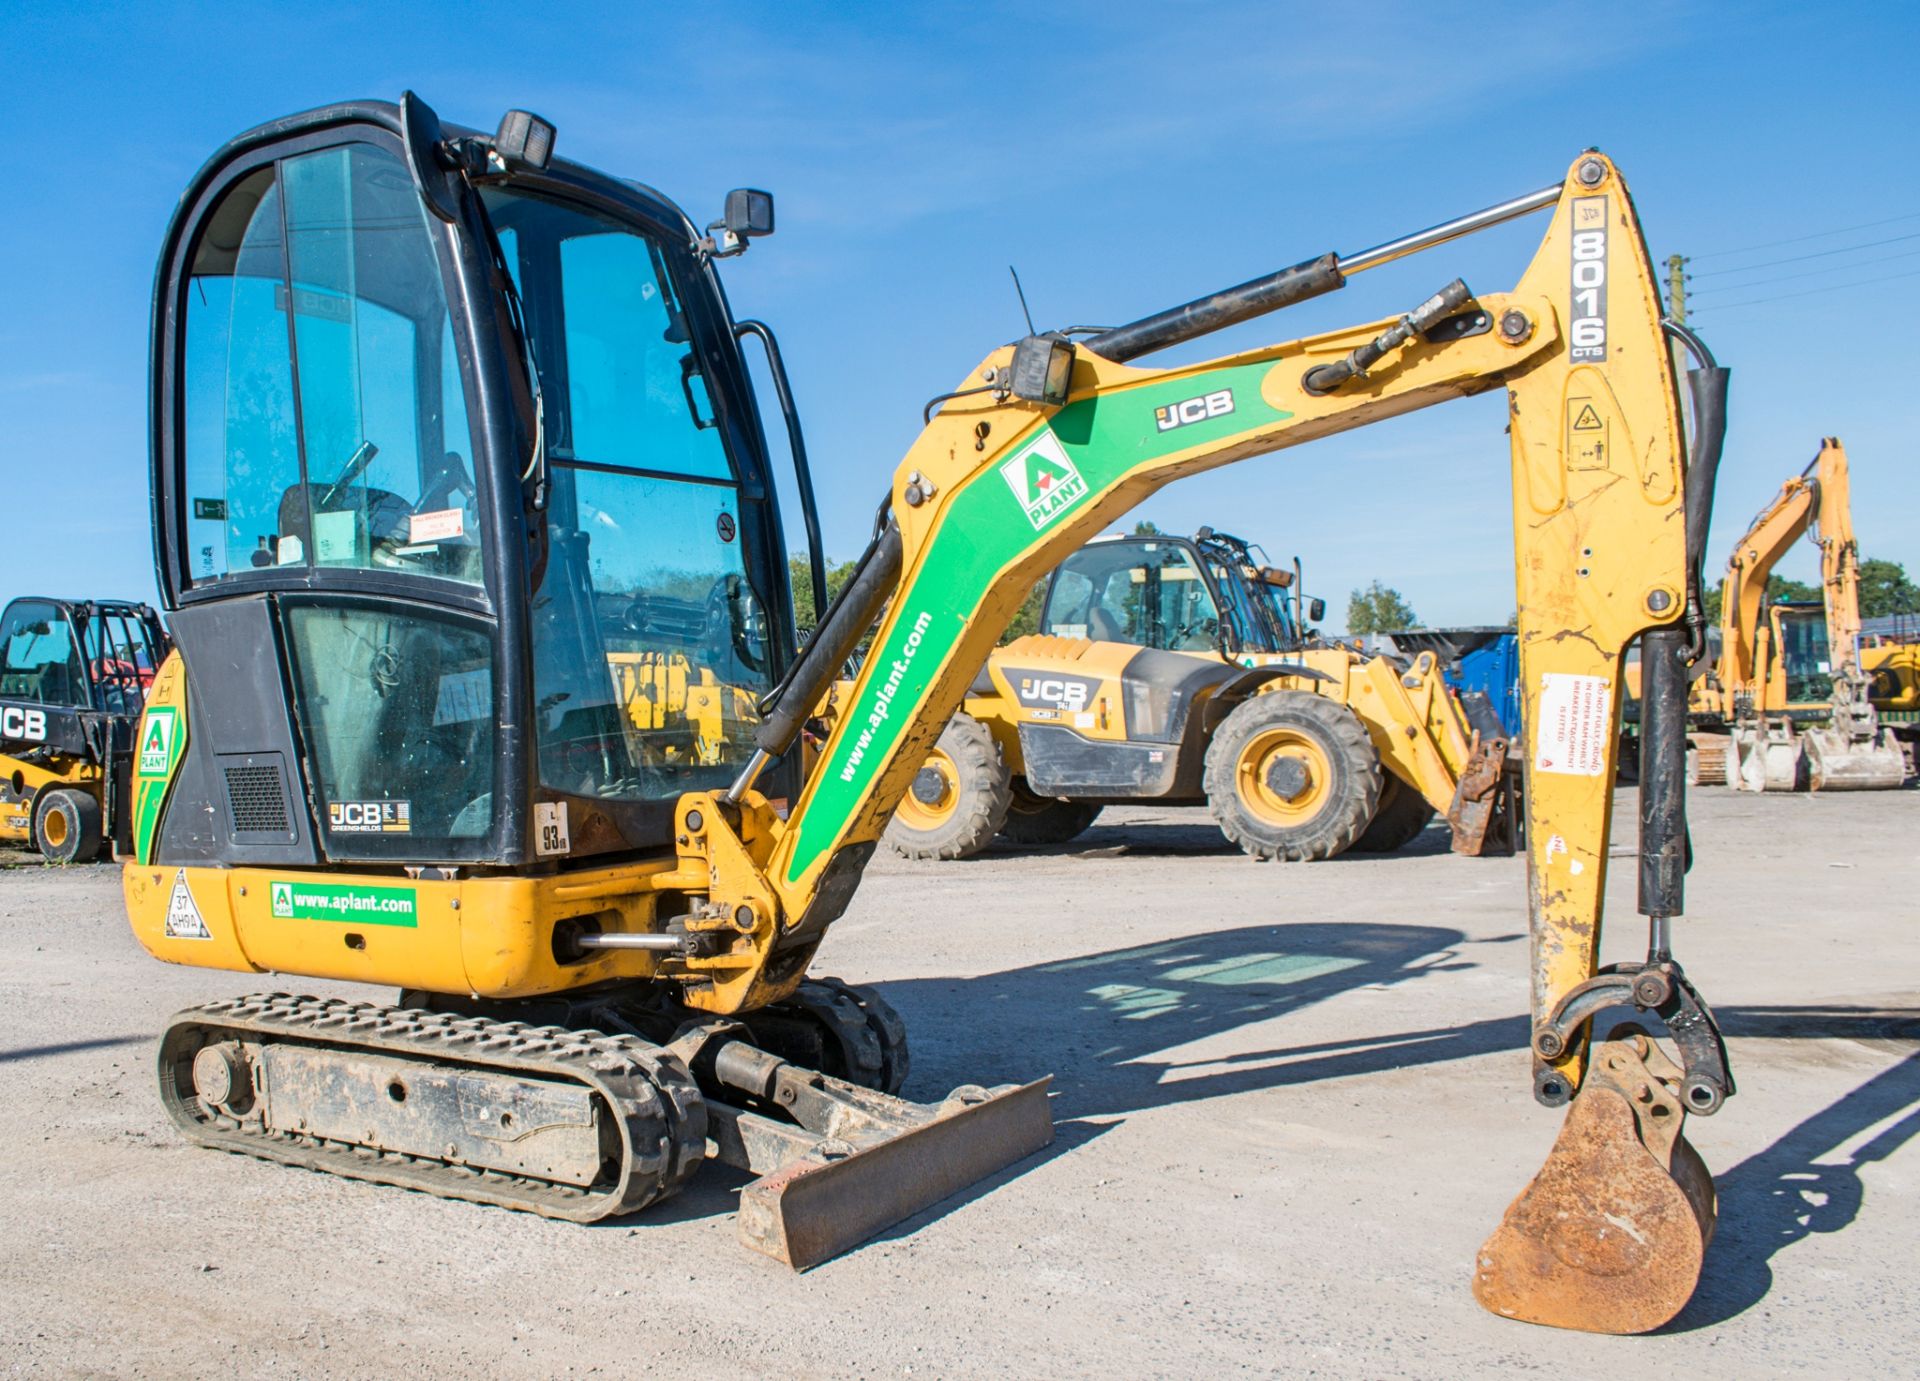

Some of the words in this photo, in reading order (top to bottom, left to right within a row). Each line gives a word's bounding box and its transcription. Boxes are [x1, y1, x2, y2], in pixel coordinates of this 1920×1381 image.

[1583, 208, 1599, 221] JCB
[1572, 232, 1605, 347] 8016
[1572, 347, 1603, 358] CTS
[1157, 390, 1234, 430] JCB
[1025, 452, 1070, 504] A
[1030, 477, 1083, 525] PLANT
[840, 611, 933, 783] www.aplant.com
[1021, 679, 1087, 703] JCB
[1596, 696, 1604, 714] NOT
[0, 706, 47, 741] CB
[144, 720, 165, 751] A
[1594, 715, 1602, 740] FULLY
[142, 756, 166, 768] PLANT
[330, 803, 382, 825] JCB
[543, 825, 559, 851] 93
[176, 895, 188, 910] 37
[293, 892, 413, 914] www.aplant.com
